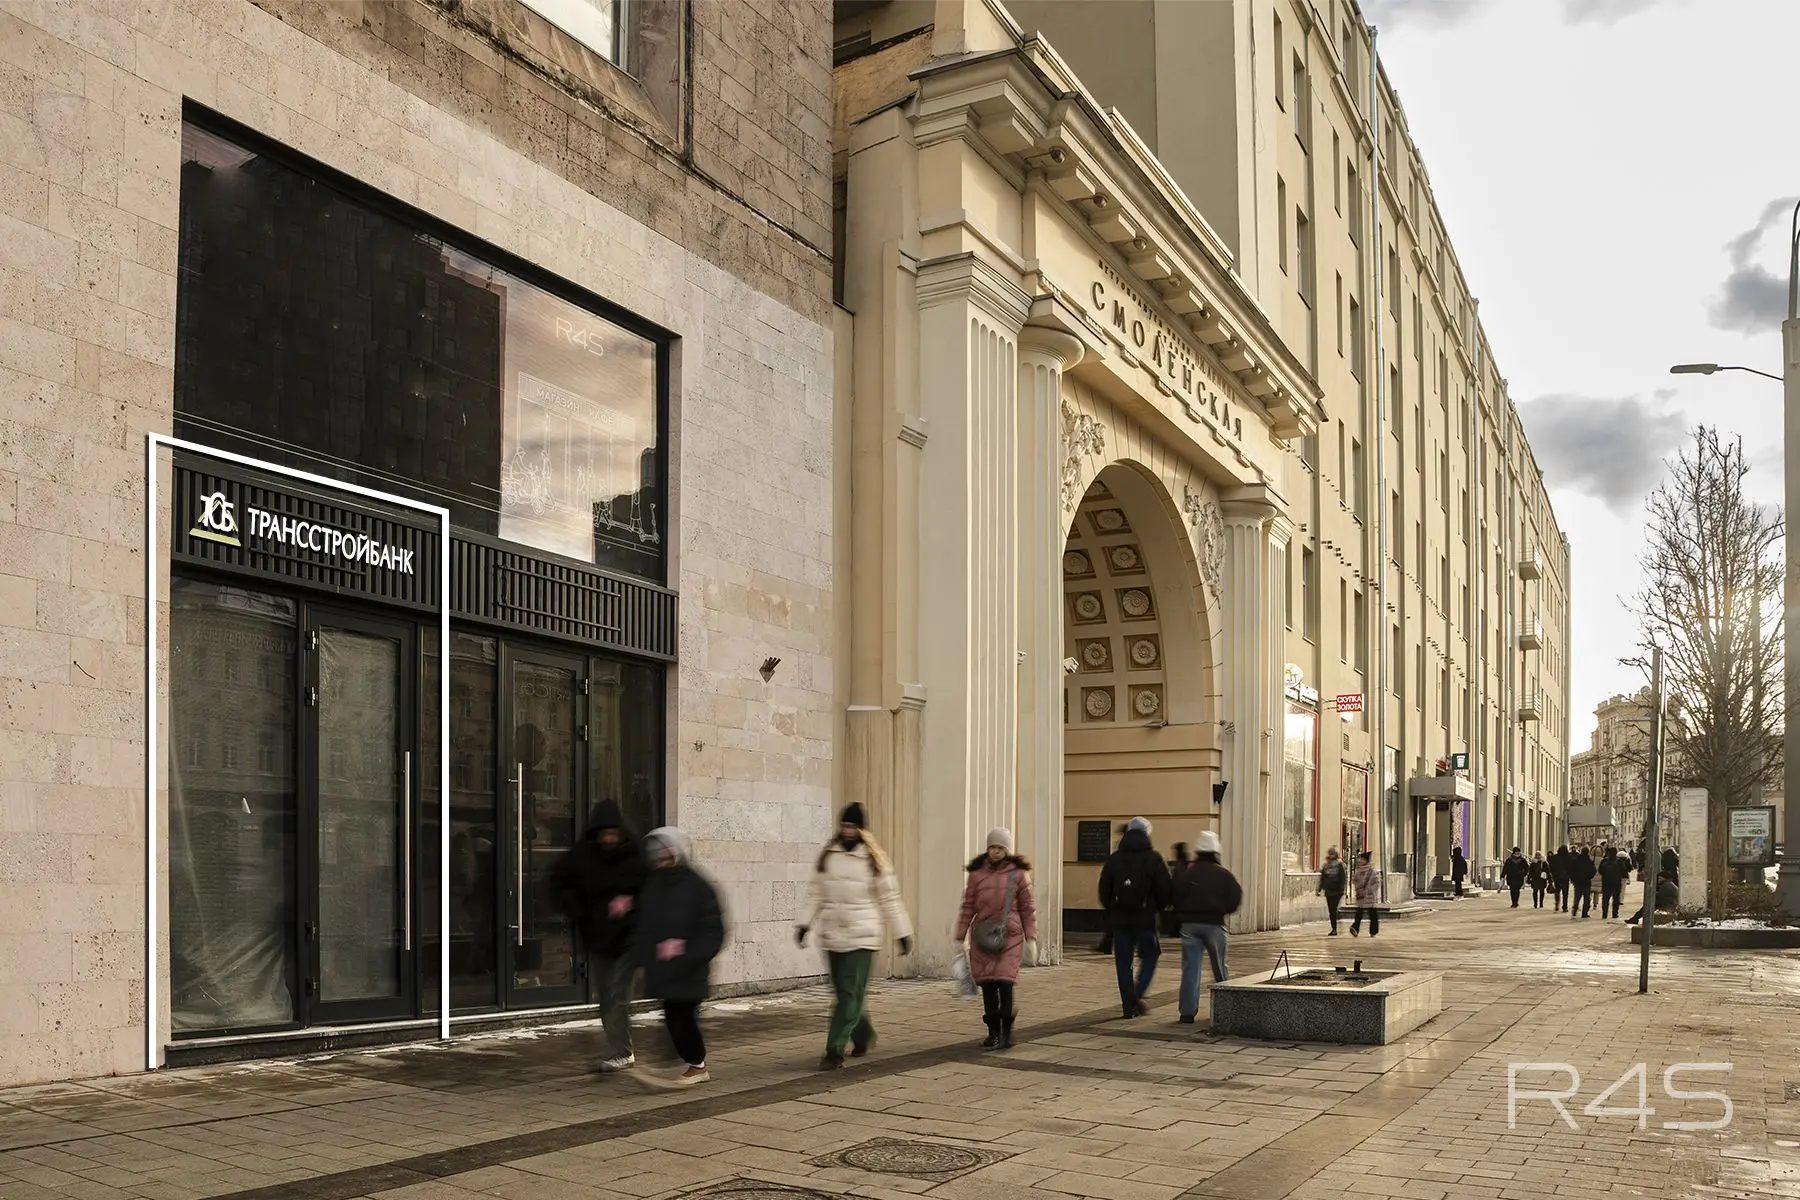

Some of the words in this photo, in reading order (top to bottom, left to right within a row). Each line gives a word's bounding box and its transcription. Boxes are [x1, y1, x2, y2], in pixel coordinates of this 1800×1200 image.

[555, 316, 604, 357] R4S
[1091, 281, 1242, 441] СМОЛЕНСКАЯ
[536, 387, 580, 413] МАГАЗИН
[248, 507, 414, 575] ТРАНССТРОЙБАНК
[1337, 695, 1362, 704] СКУПКА
[1337, 703, 1362, 711] ЗОЛОТА
